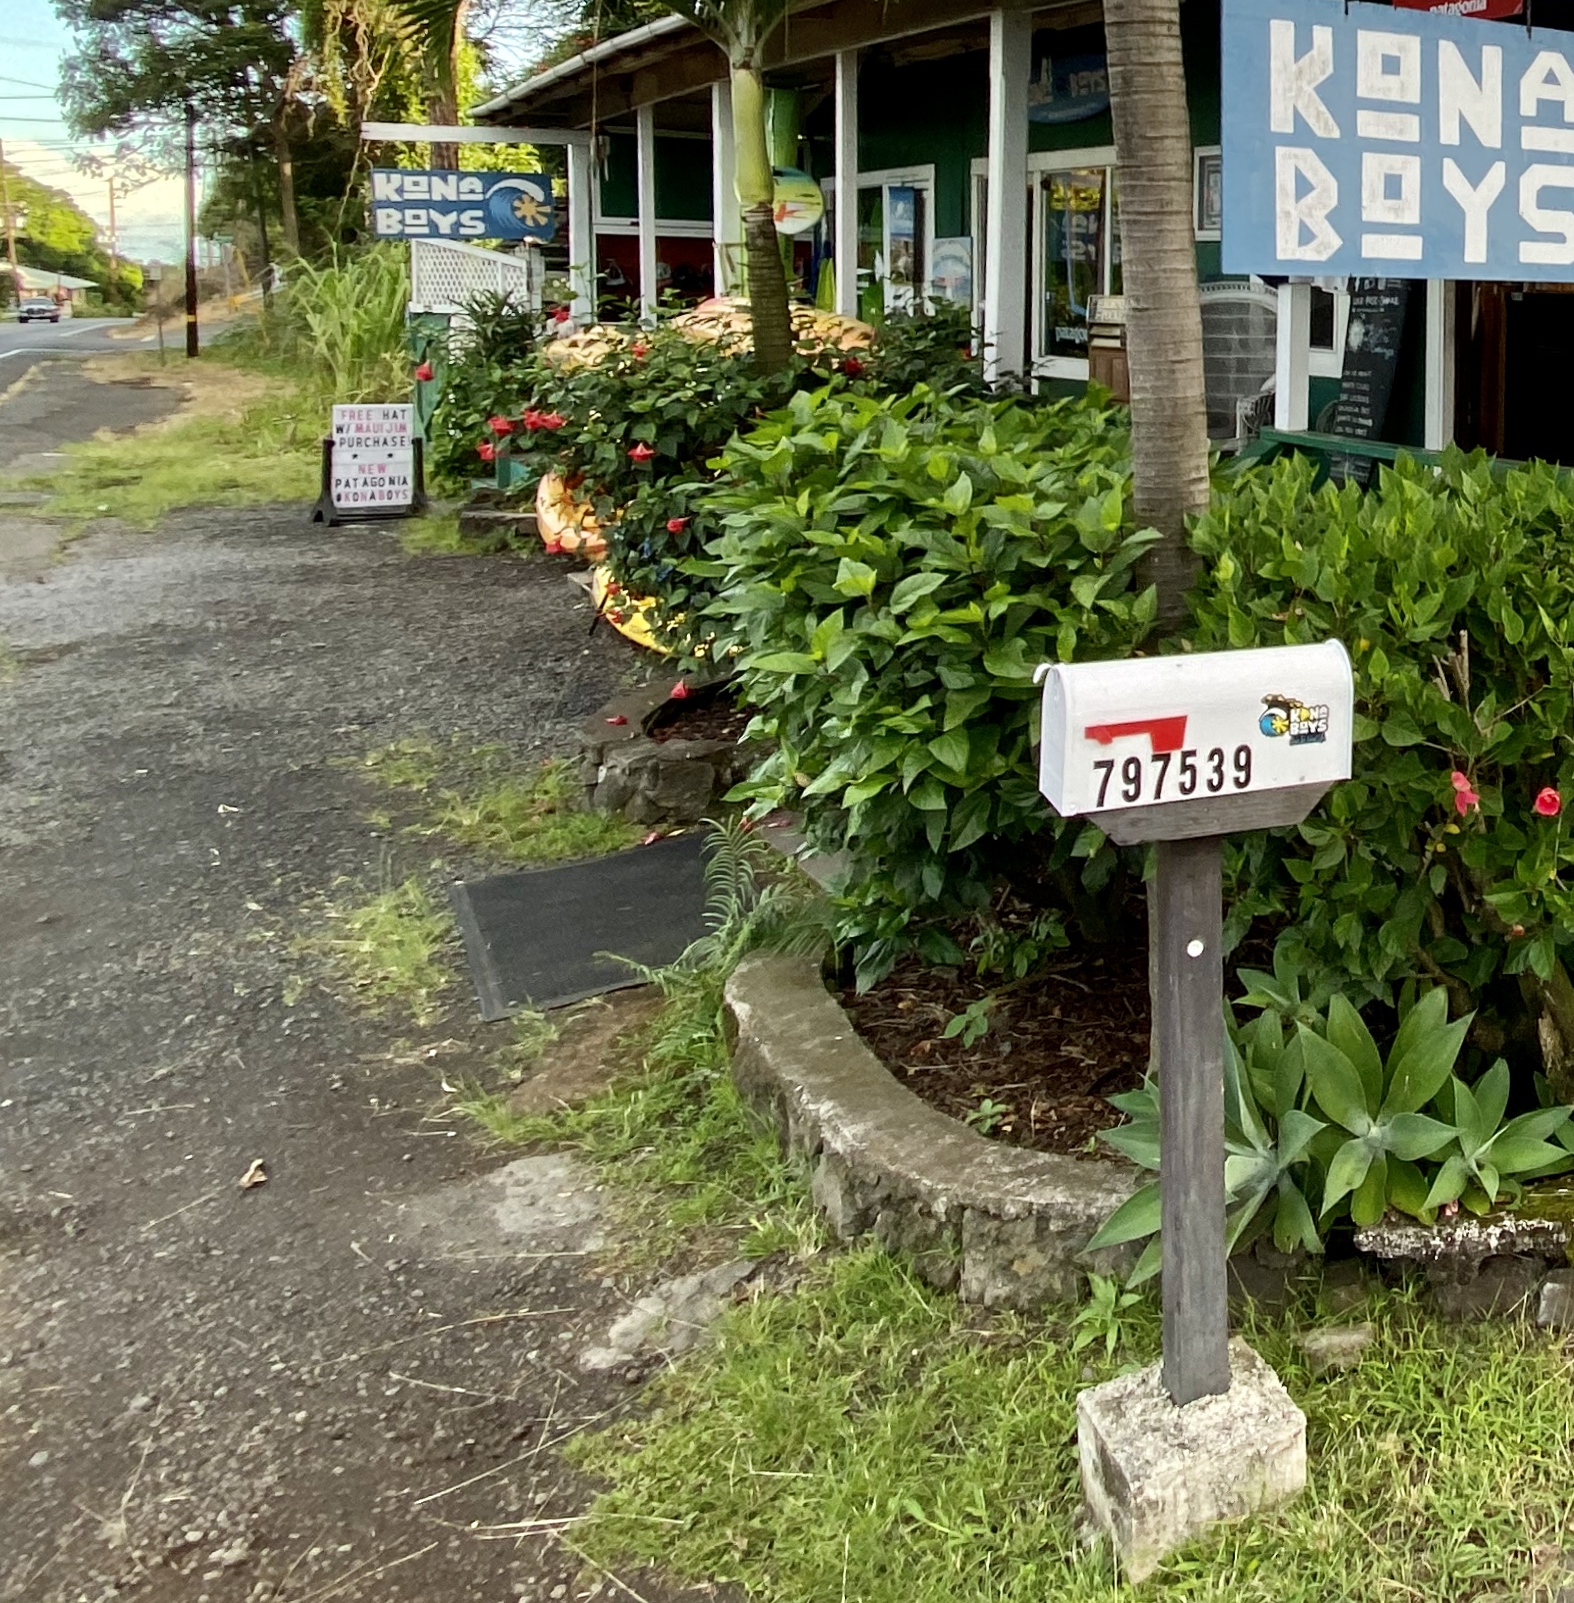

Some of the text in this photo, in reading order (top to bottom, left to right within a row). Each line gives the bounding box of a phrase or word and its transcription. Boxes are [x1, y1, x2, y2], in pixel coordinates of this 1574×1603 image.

[373, 173, 484, 202] KONA
[376, 208, 486, 236] BOYS
[341, 408, 408, 421] FREE HAT
[336, 424, 351, 434] W/
[358, 464, 387, 475] NEW
[335, 476, 408, 489] PATAGONIA
[1290, 705, 1329, 723] KONA
[1290, 719, 1328, 736] BOYS
[1093, 744, 1252, 808] 797539
